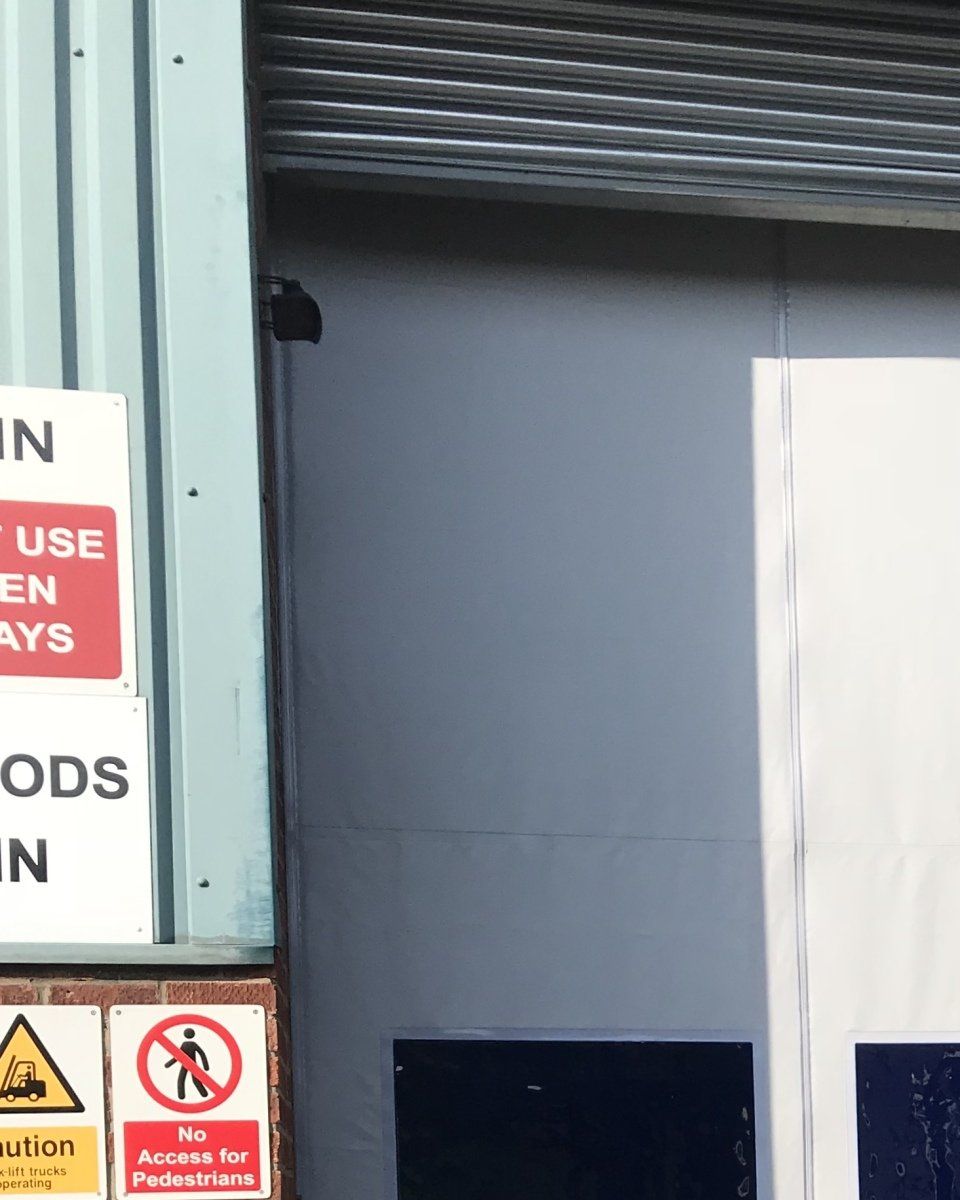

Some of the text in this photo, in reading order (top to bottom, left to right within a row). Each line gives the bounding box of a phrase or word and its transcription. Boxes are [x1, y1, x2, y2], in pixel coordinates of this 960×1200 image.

[16, 525, 105, 560] USE
[0, 753, 129, 800] ODS
[0, 838, 48, 883] N
[178, 1126, 207, 1142] No
[0, 1134, 75, 1157] ution
[137, 1148, 249, 1165] Access for
[30, 1166, 67, 1177] trucks
[132, 1170, 255, 1188] Pedestrians
